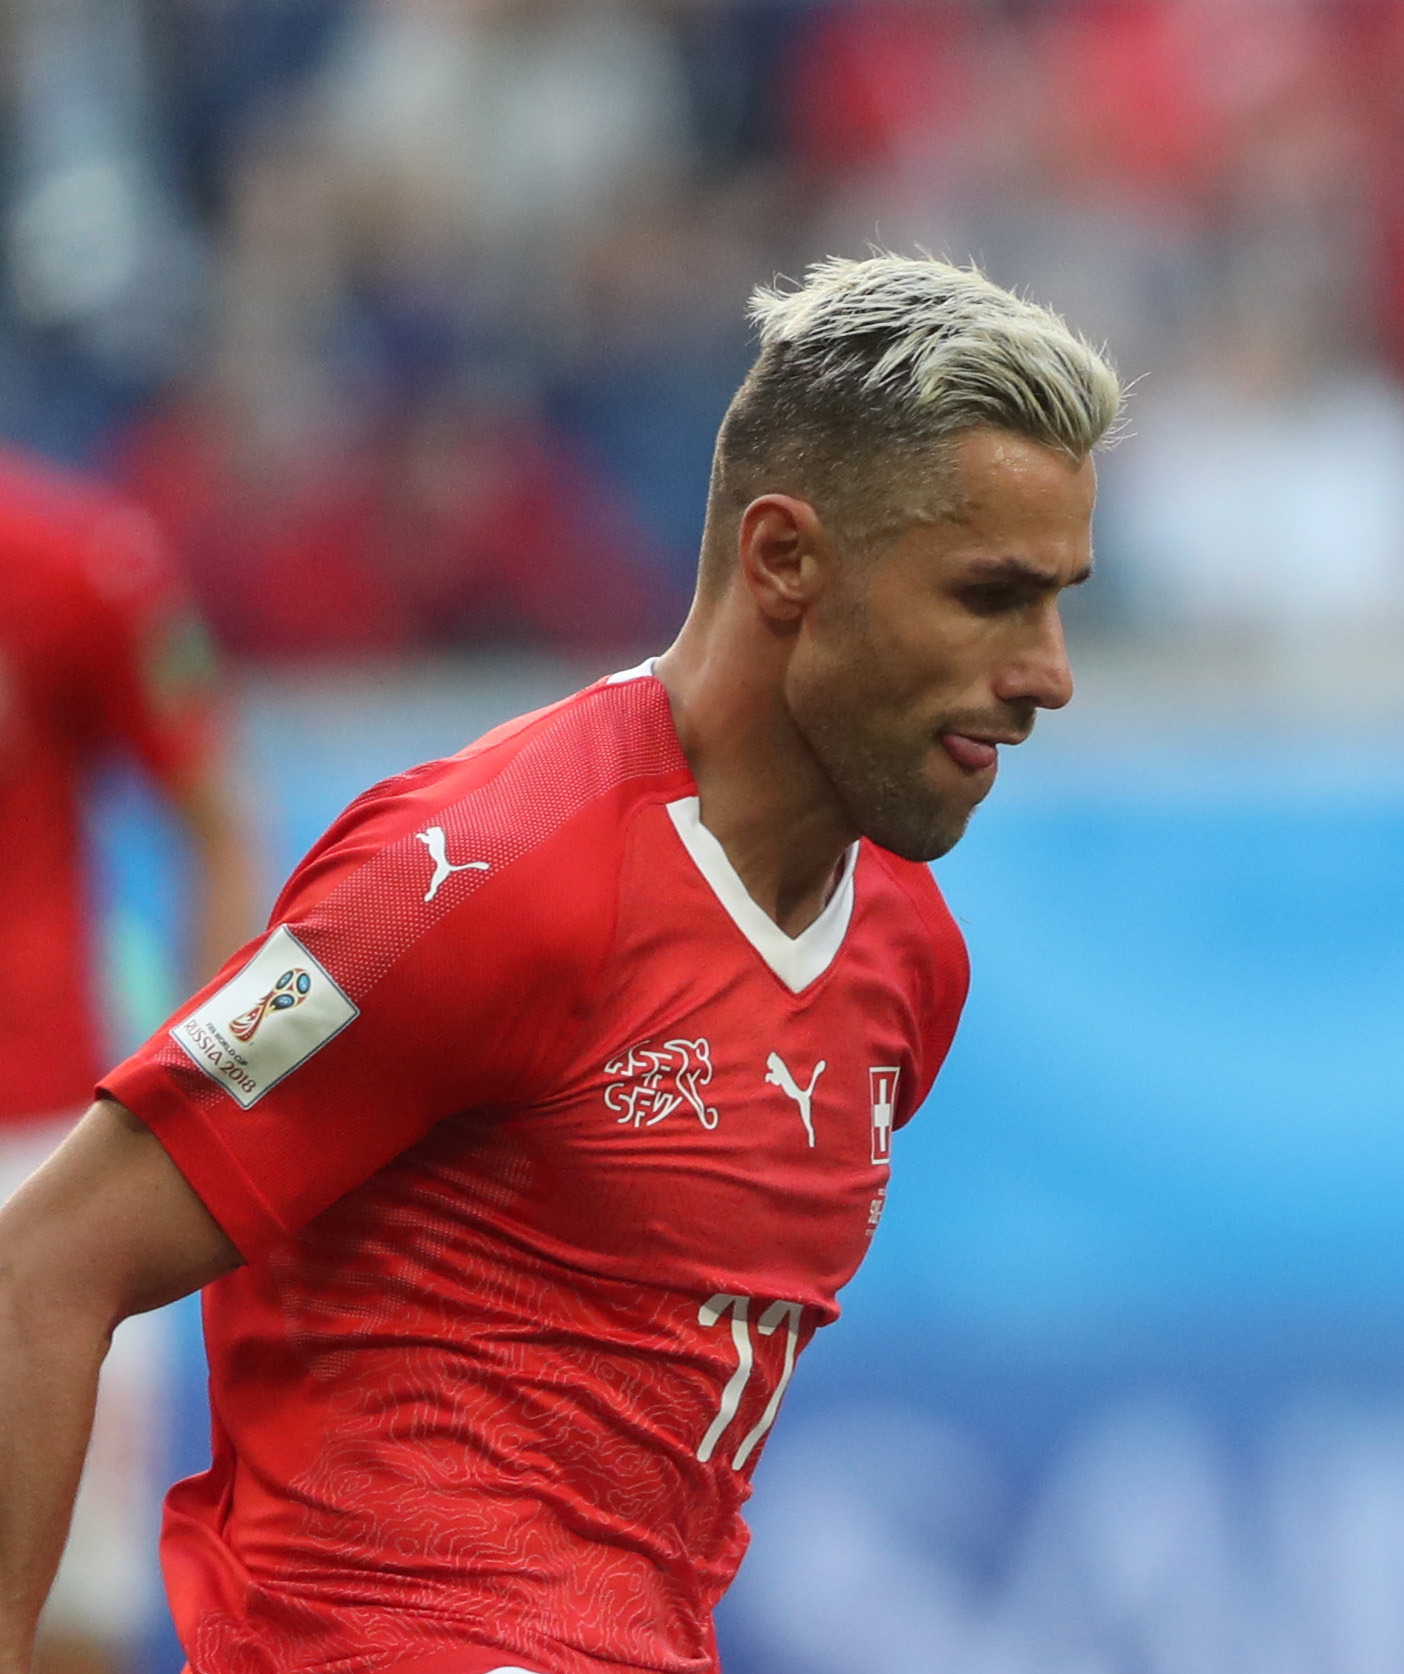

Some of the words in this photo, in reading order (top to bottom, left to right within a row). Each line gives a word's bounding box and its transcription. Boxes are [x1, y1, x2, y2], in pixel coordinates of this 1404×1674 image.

[184, 1019, 223, 1066] RUSSIA
[219, 1060, 257, 1094] 2018
[214, 1031, 236, 1056] WORLD
